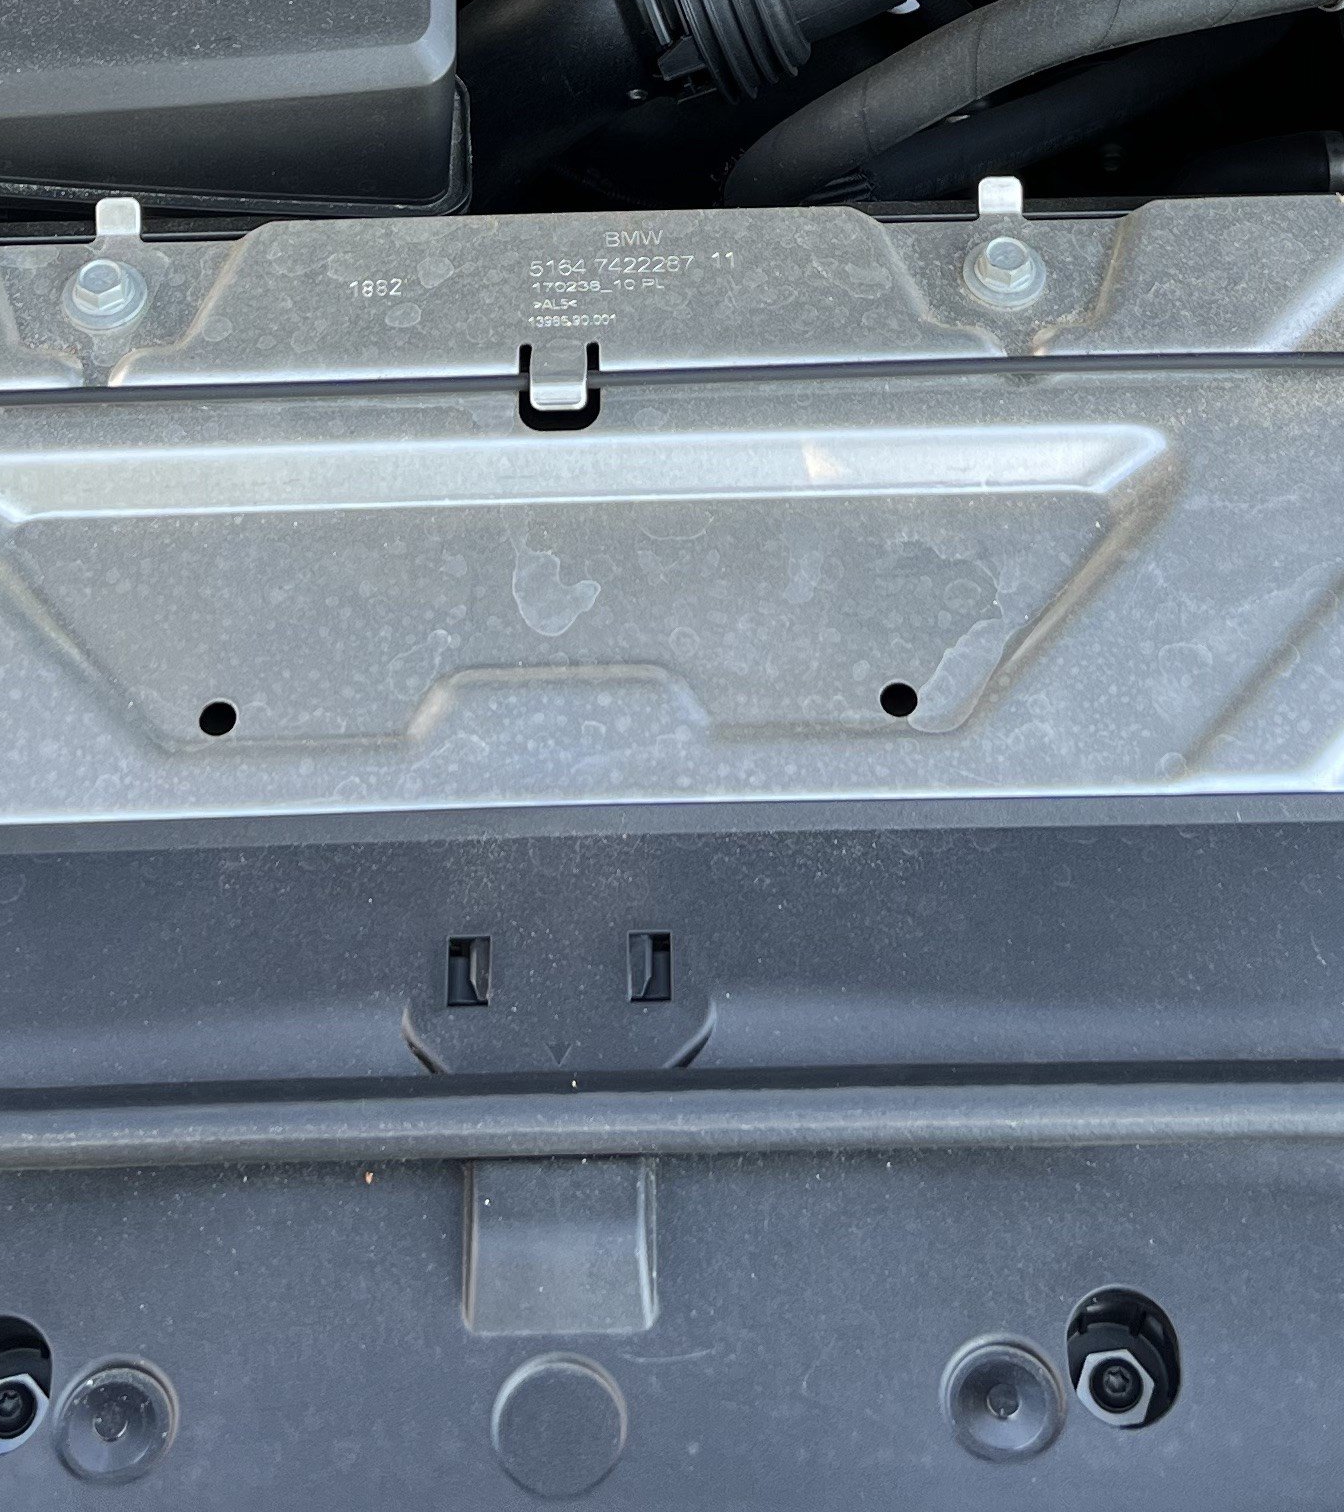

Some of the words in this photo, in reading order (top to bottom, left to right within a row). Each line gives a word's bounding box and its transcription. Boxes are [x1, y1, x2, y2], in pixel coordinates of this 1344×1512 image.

[604, 230, 663, 247] BMW
[529, 259, 586, 277] 5164
[593, 255, 695, 274] 7422287
[711, 251, 735, 269] 11
[349, 278, 402, 298] 1882
[640, 278, 666, 289] PL
